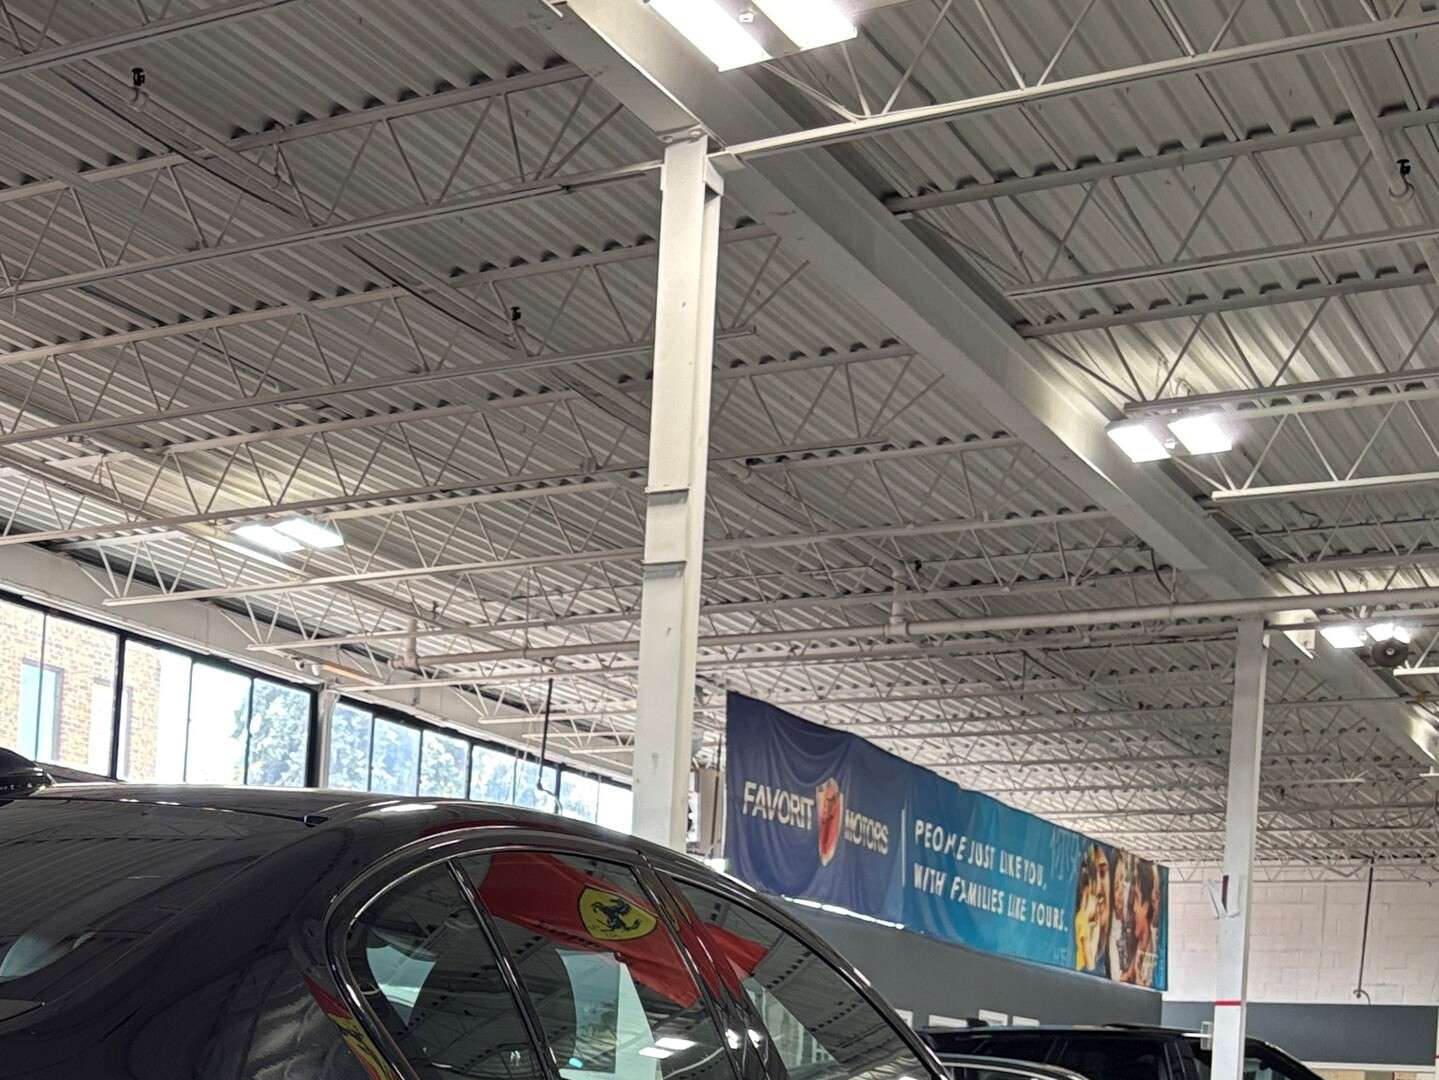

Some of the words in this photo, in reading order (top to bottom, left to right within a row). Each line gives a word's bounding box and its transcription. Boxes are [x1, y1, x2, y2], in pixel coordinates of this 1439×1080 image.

[742, 781, 815, 830] FAVORIT
[844, 809, 889, 855] MOTORS
[968, 841, 996, 871] JUST
[999, 850, 1022, 880] LIKE
[914, 862, 947, 897] WITH
[950, 876, 1005, 915] FAMILIES
[1007, 893, 1027, 922] LIKE
